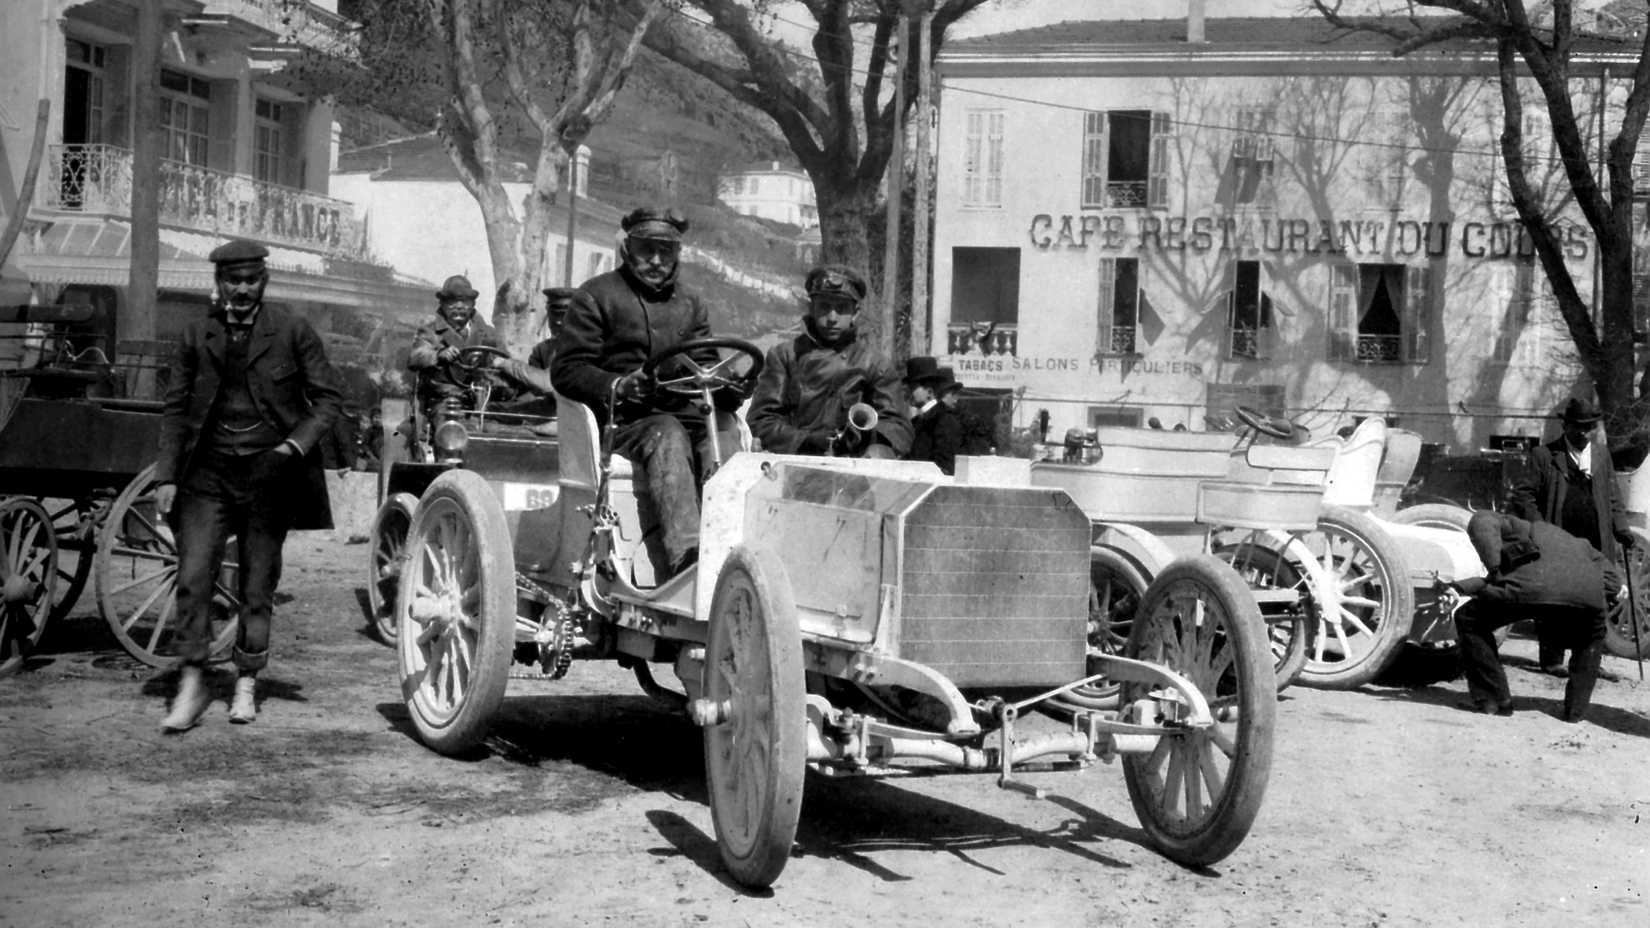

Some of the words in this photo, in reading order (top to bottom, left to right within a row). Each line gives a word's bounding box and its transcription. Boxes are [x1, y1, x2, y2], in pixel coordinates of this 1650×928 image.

[1028, 213, 1126, 251] CAFE
[1137, 215, 1385, 255] RESTAURANT
[1396, 220, 1449, 257] DU
[958, 359, 1003, 372] TABACS
[1012, 357, 1079, 371] SALONS
[1089, 358, 1203, 375] PRCULIERS
